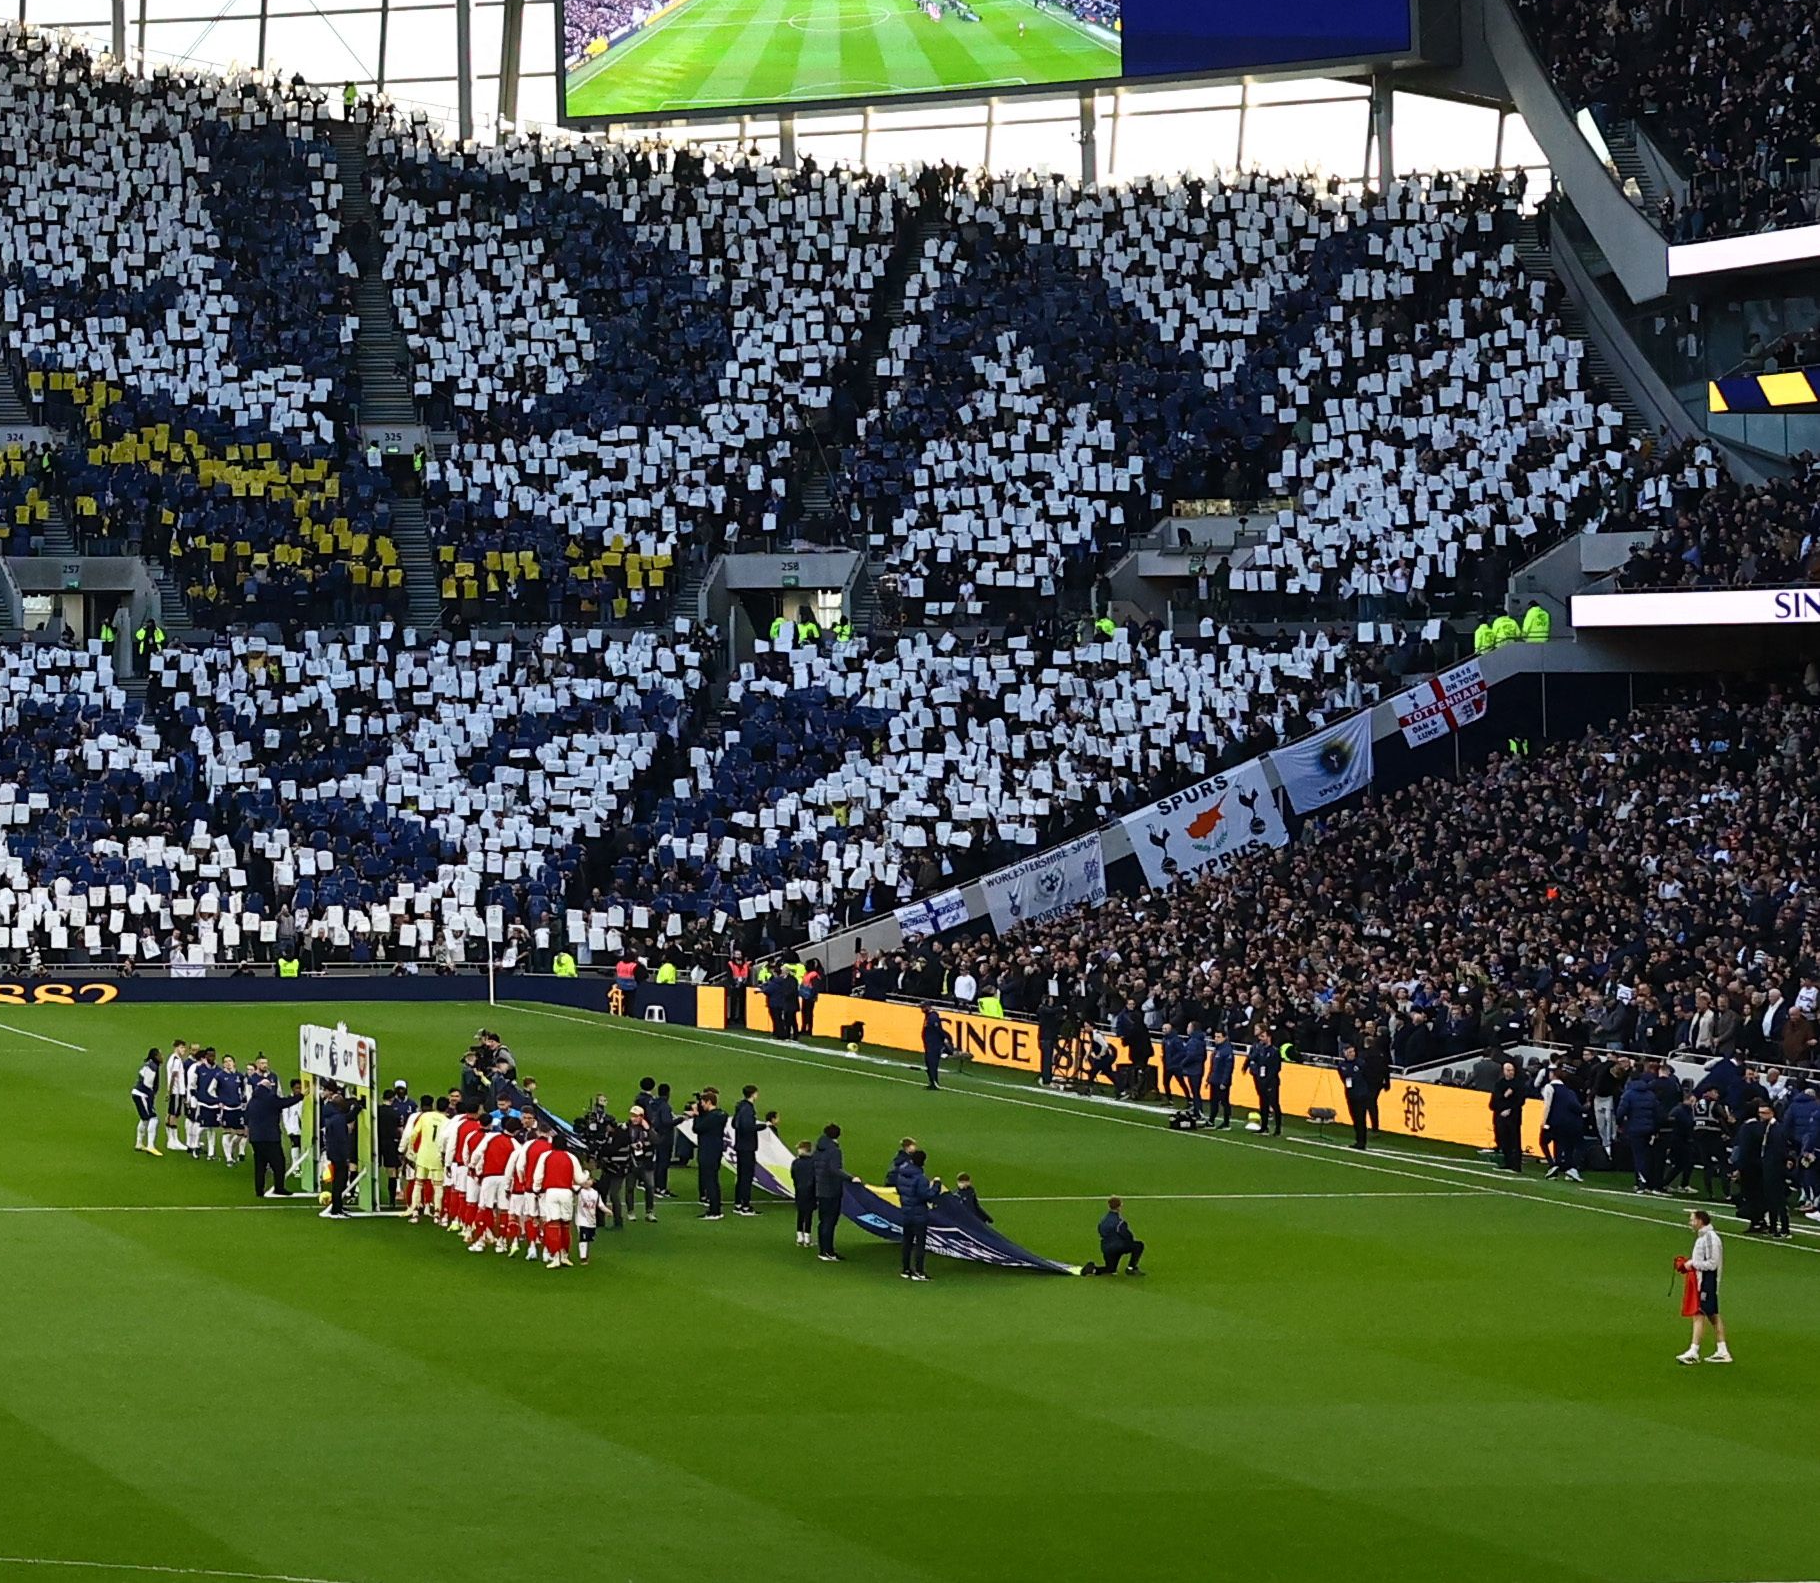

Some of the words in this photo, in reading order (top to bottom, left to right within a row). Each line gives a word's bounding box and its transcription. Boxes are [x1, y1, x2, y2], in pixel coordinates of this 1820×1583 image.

[6, 433, 23, 441] 324
[385, 433, 402, 441] 325
[63, 565, 80, 574] 257
[781, 562, 799, 571] 258
[1445, 683, 1458, 692] ON
[1460, 672, 1480, 687] TOUR
[1405, 684, 1481, 724] TOTTENHAM
[1412, 723, 1429, 734] DAN
[1417, 727, 1439, 740] LUKE
[1157, 775, 1228, 816] SPURS
[984, 847, 1067, 888] WORCESTERSHIRE
[1179, 838, 1261, 884] CYPRUS
